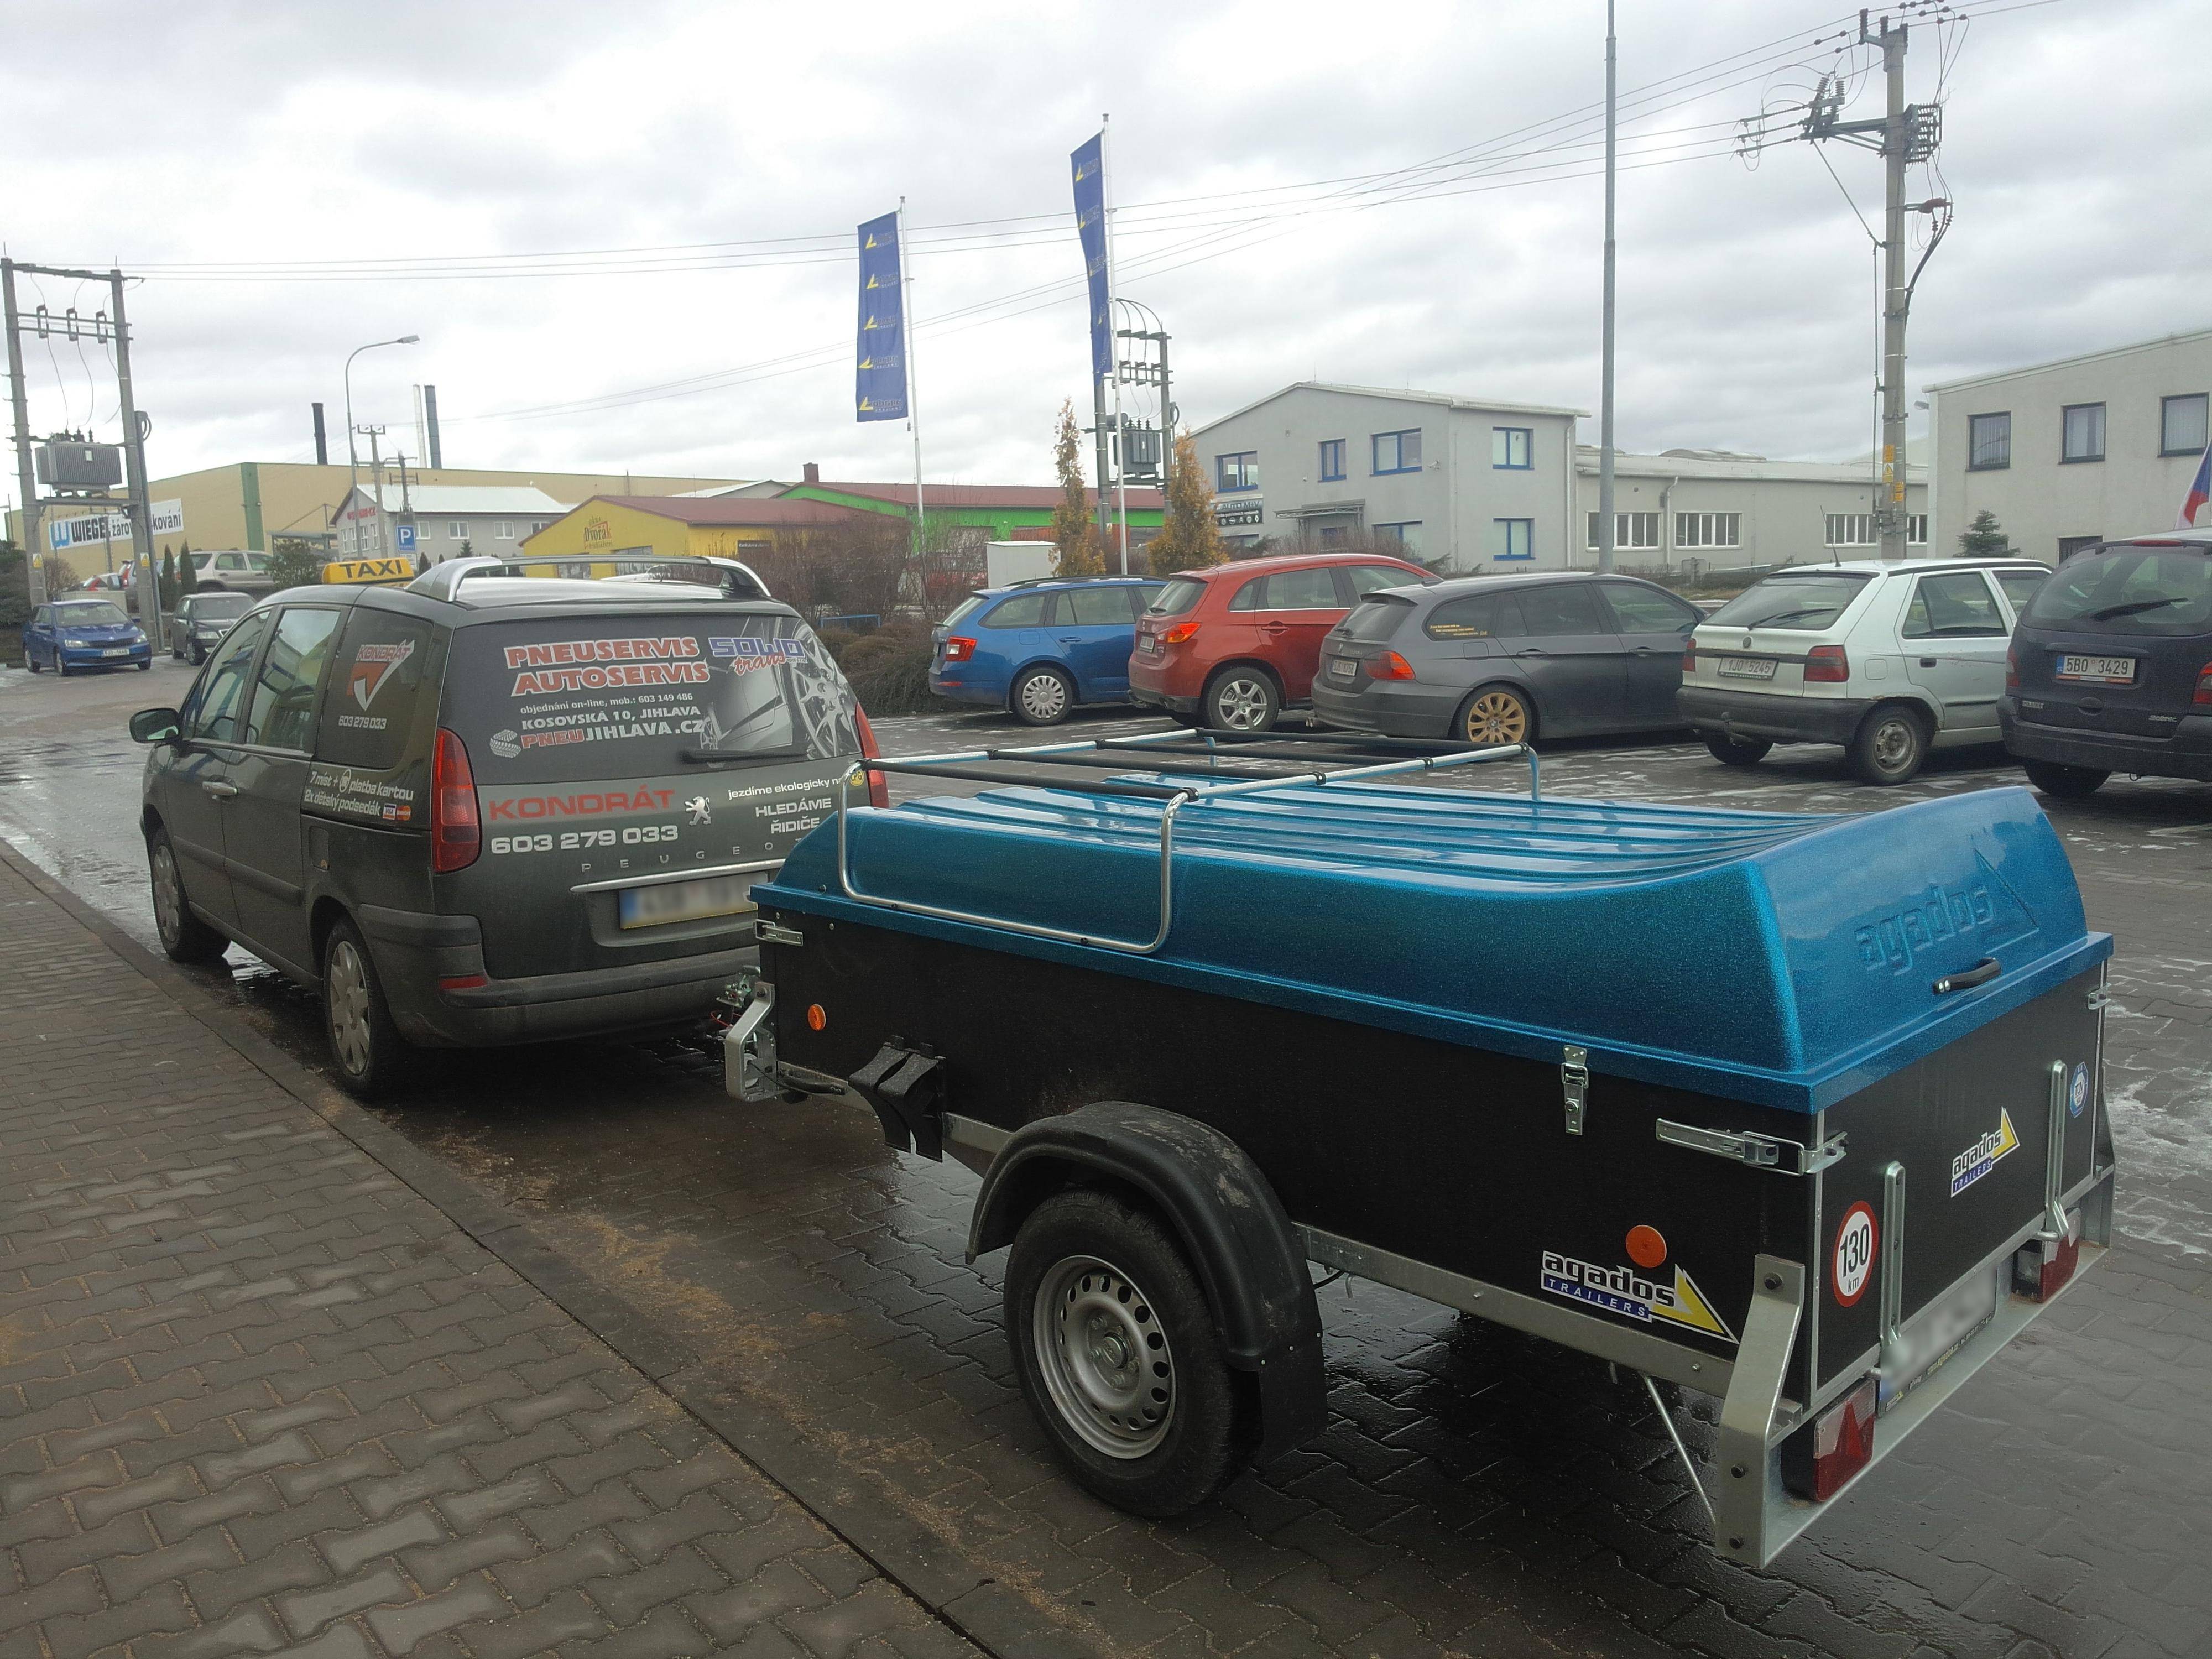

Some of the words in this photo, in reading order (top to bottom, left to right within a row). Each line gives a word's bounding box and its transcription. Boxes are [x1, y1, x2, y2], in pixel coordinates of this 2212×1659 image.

[71, 515, 110, 542] WIEGE
[400, 529, 411, 544] P
[585, 525, 612, 541] Dvořák
[339, 559, 403, 579] TAXI
[504, 637, 700, 669] PNEUSERVIS
[708, 638, 805, 657] SOWO
[734, 651, 786, 676] trans
[1747, 660, 1772, 674] 5245
[2066, 658, 2089, 672] 5B0
[2098, 659, 2128, 675] 3429
[511, 661, 710, 697] AUTOSERVIS
[520, 701, 569, 715] objednání
[571, 698, 608, 708] on-line,
[610, 696, 637, 706] mob.:
[638, 694, 655, 703] 603
[658, 693, 675, 702] 149
[676, 692, 693, 701] 486
[339, 715, 354, 727] 603
[353, 717, 370, 729] 279
[369, 718, 387, 730] 033
[521, 710, 609, 731] KOSOVSKÁ
[613, 710, 636, 721] 10,
[640, 706, 701, 719] JIHLAVA
[310, 771, 317, 783] 7
[316, 772, 333, 786] míst
[348, 779, 377, 794] platba
[377, 782, 414, 801] kartou
[728, 786, 773, 800] jezdíme
[775, 779, 830, 792] ekologicky
[304, 789, 314, 802] 2x
[314, 791, 340, 811] dětský
[338, 798, 381, 816] podsedák
[488, 784, 676, 821] KONDRÁT
[755, 797, 832, 817] HLEDÁME
[771, 815, 820, 834] ŘIDIČE
[491, 834, 554, 854] 603
[560, 830, 617, 850] 279
[622, 825, 679, 845] 033
[1855, 883, 1995, 975] agados
[1953, 1129, 2001, 1177] agados
[1954, 1160, 1991, 1191] TRAILERS
[1840, 1223, 1870, 1277] 130
[1543, 1251, 1676, 1308] agados
[1848, 1276, 1859, 1293] km
[1548, 1279, 1646, 1317] TRAILERS
